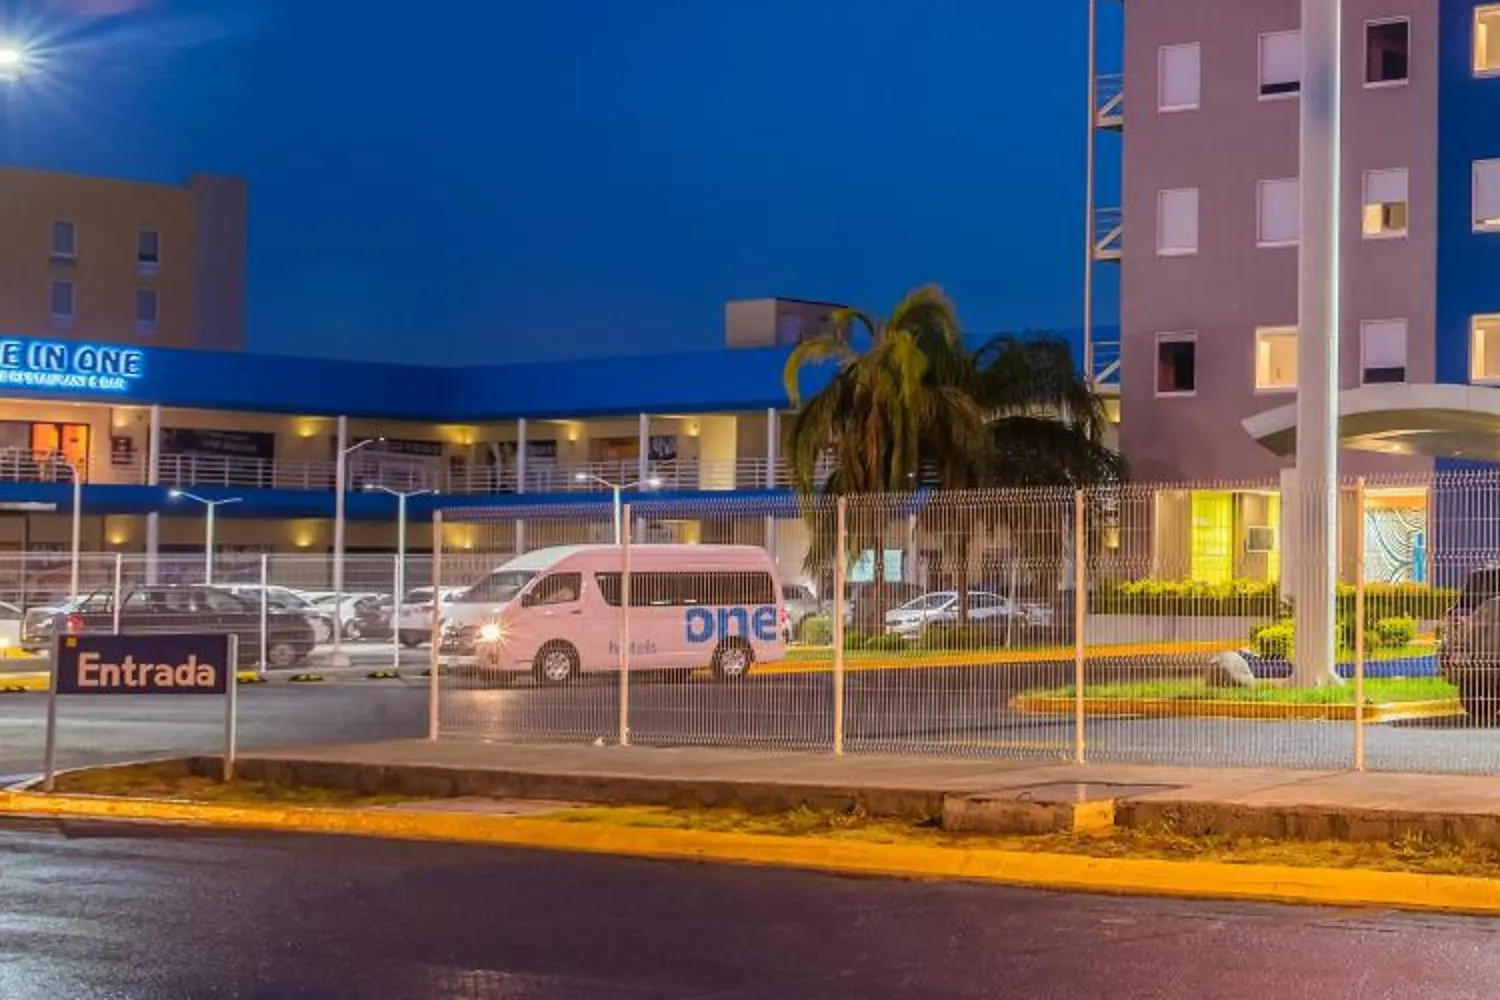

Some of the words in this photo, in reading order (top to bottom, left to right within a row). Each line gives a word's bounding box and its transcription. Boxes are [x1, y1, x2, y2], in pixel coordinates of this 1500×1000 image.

[30, 342, 67, 371] IN
[75, 346, 142, 377] ONE
[609, 638, 657, 656] htels
[686, 606, 777, 643] one
[78, 653, 215, 688] Entrada
